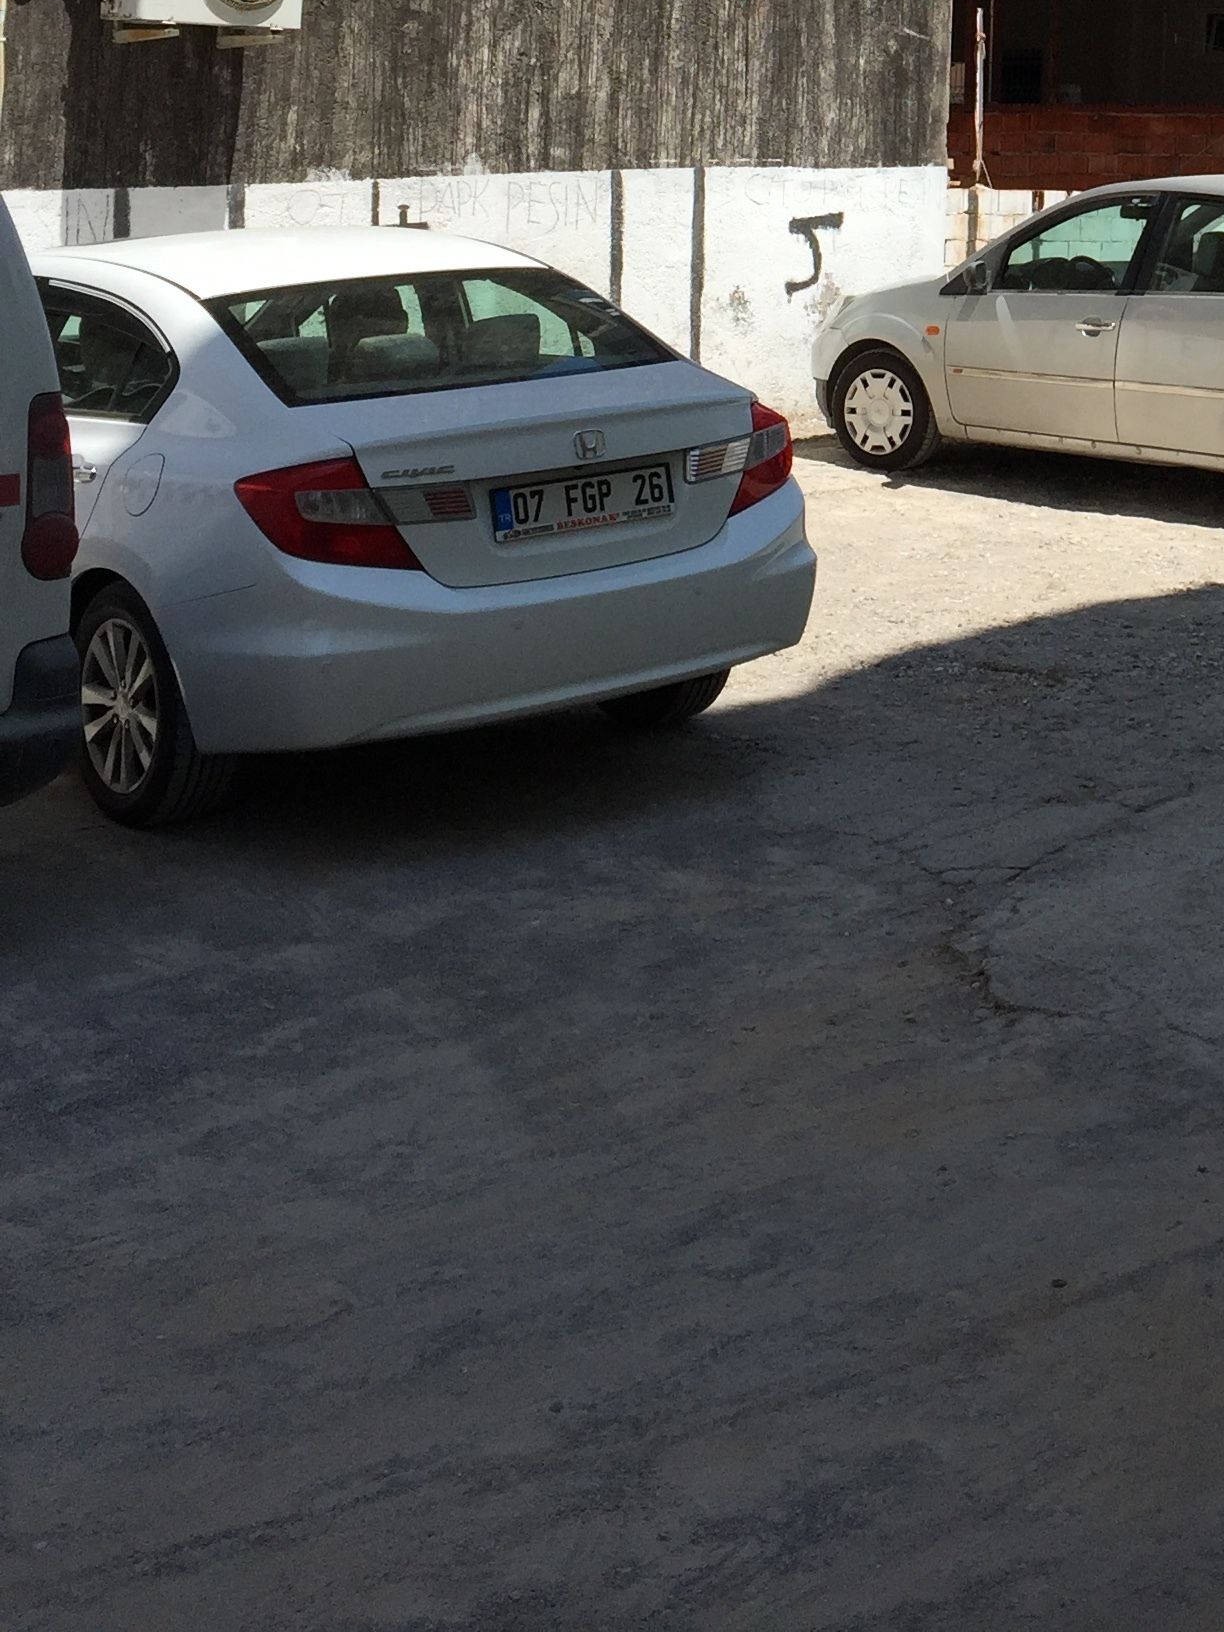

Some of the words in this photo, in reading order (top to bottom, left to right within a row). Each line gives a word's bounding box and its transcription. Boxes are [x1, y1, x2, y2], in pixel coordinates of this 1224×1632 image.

[513, 489, 544, 525] 07
[564, 479, 612, 517] FGP
[632, 471, 664, 506] 26
